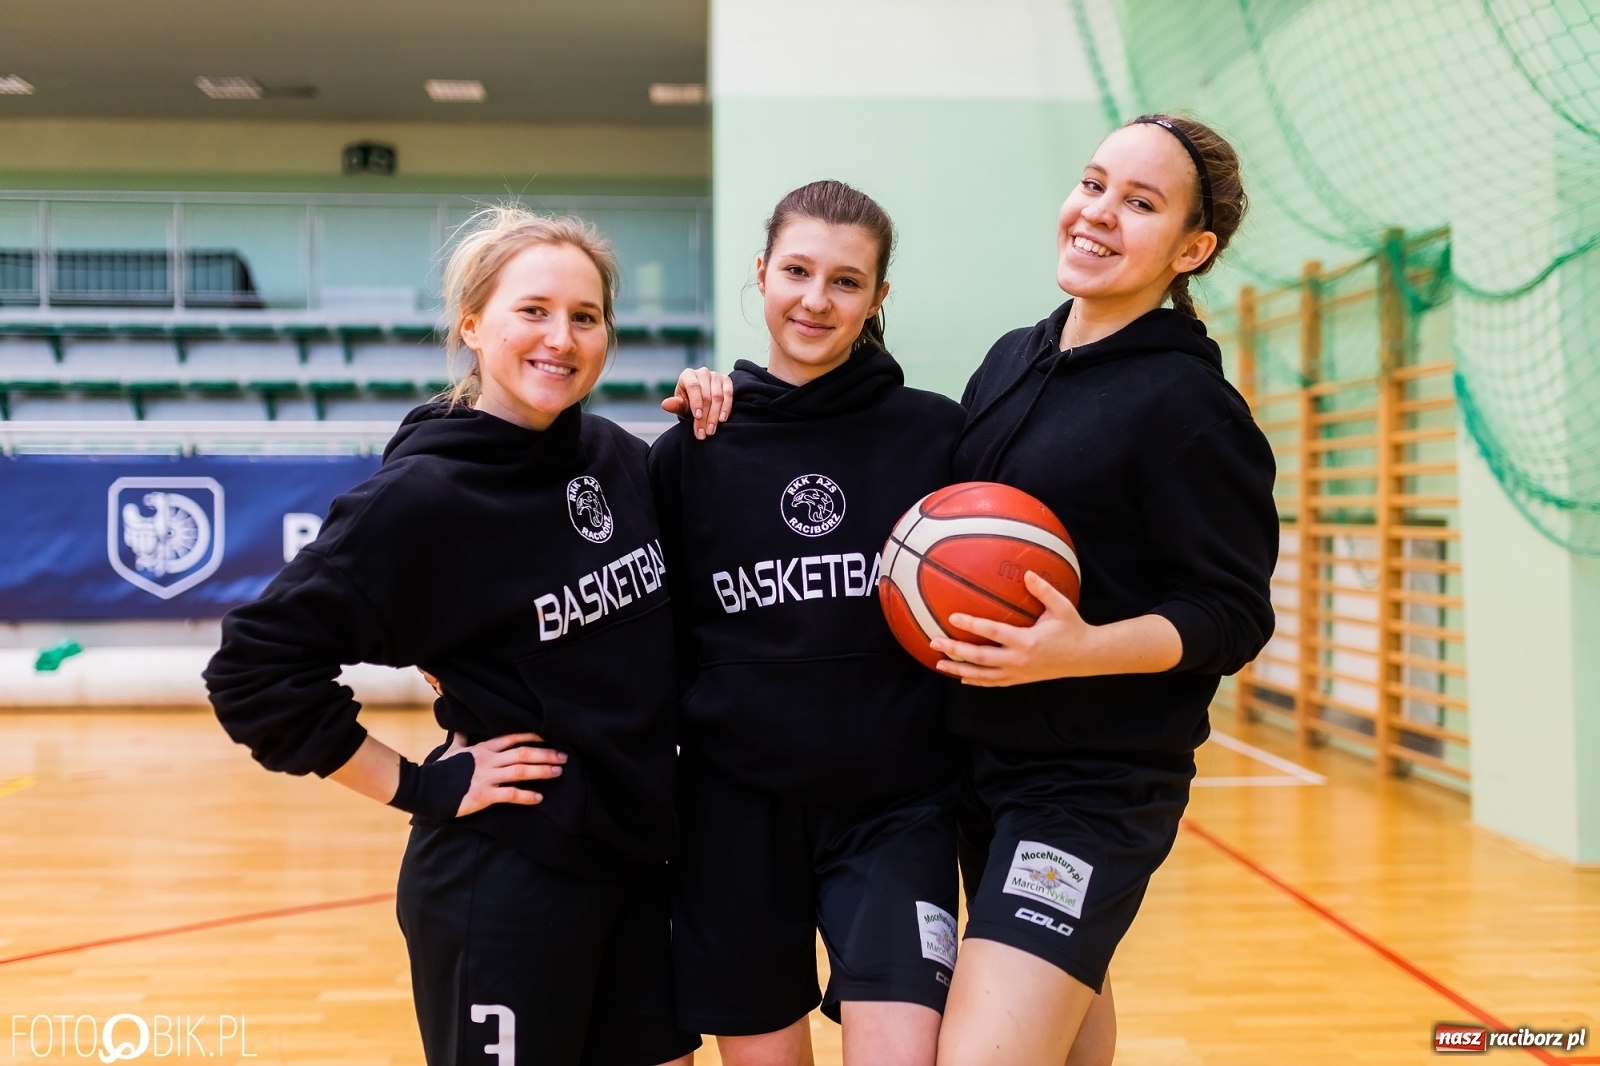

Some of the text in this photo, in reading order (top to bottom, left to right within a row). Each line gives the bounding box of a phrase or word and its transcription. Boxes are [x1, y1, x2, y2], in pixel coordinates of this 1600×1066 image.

[569, 477, 600, 502] RKK AZS
[786, 477, 837, 496] RKK AZS
[581, 514, 612, 541] RACIBÓRZ
[788, 512, 841, 535] RACIBÓRZ
[1020, 851, 1084, 883] MoceNatury.pl
[1011, 876, 1077, 908] Marcin Nykiel
[1014, 907, 1074, 937] COLO
